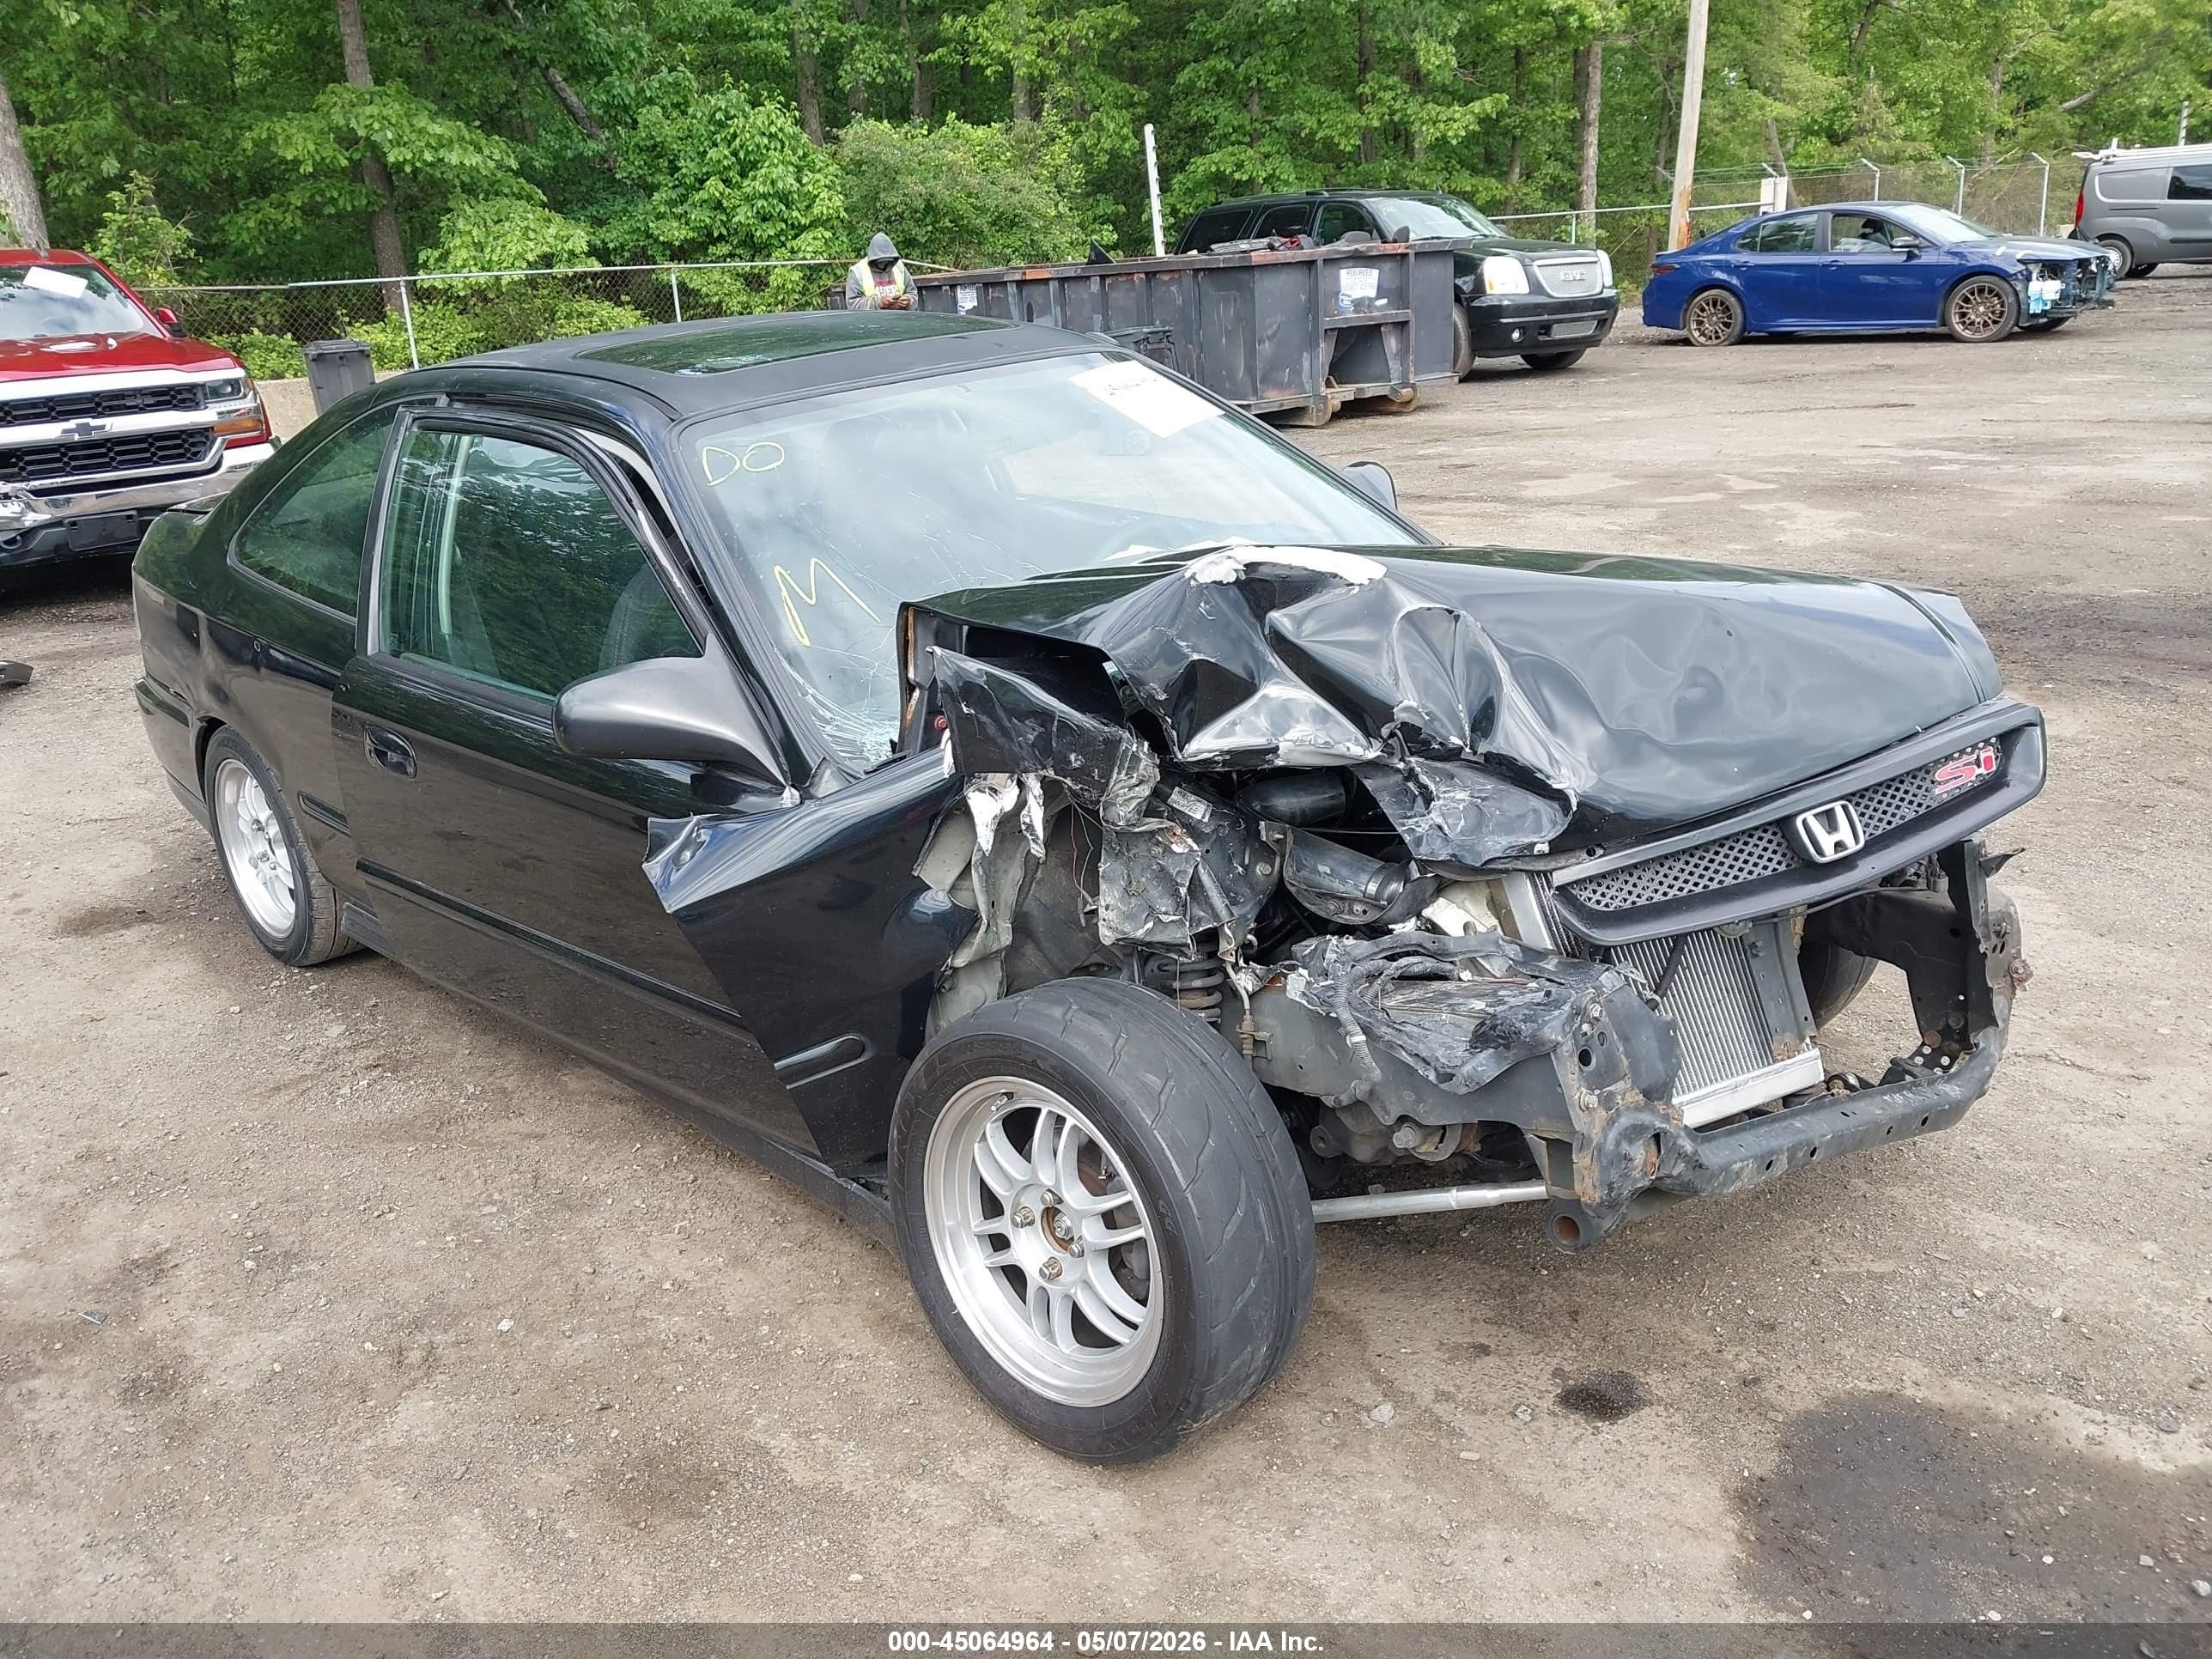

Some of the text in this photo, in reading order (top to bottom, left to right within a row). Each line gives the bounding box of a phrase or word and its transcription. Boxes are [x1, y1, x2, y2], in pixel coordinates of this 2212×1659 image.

[702, 441, 785, 486] DO
[773, 557, 882, 647] M
[1935, 745, 1996, 795] Si
